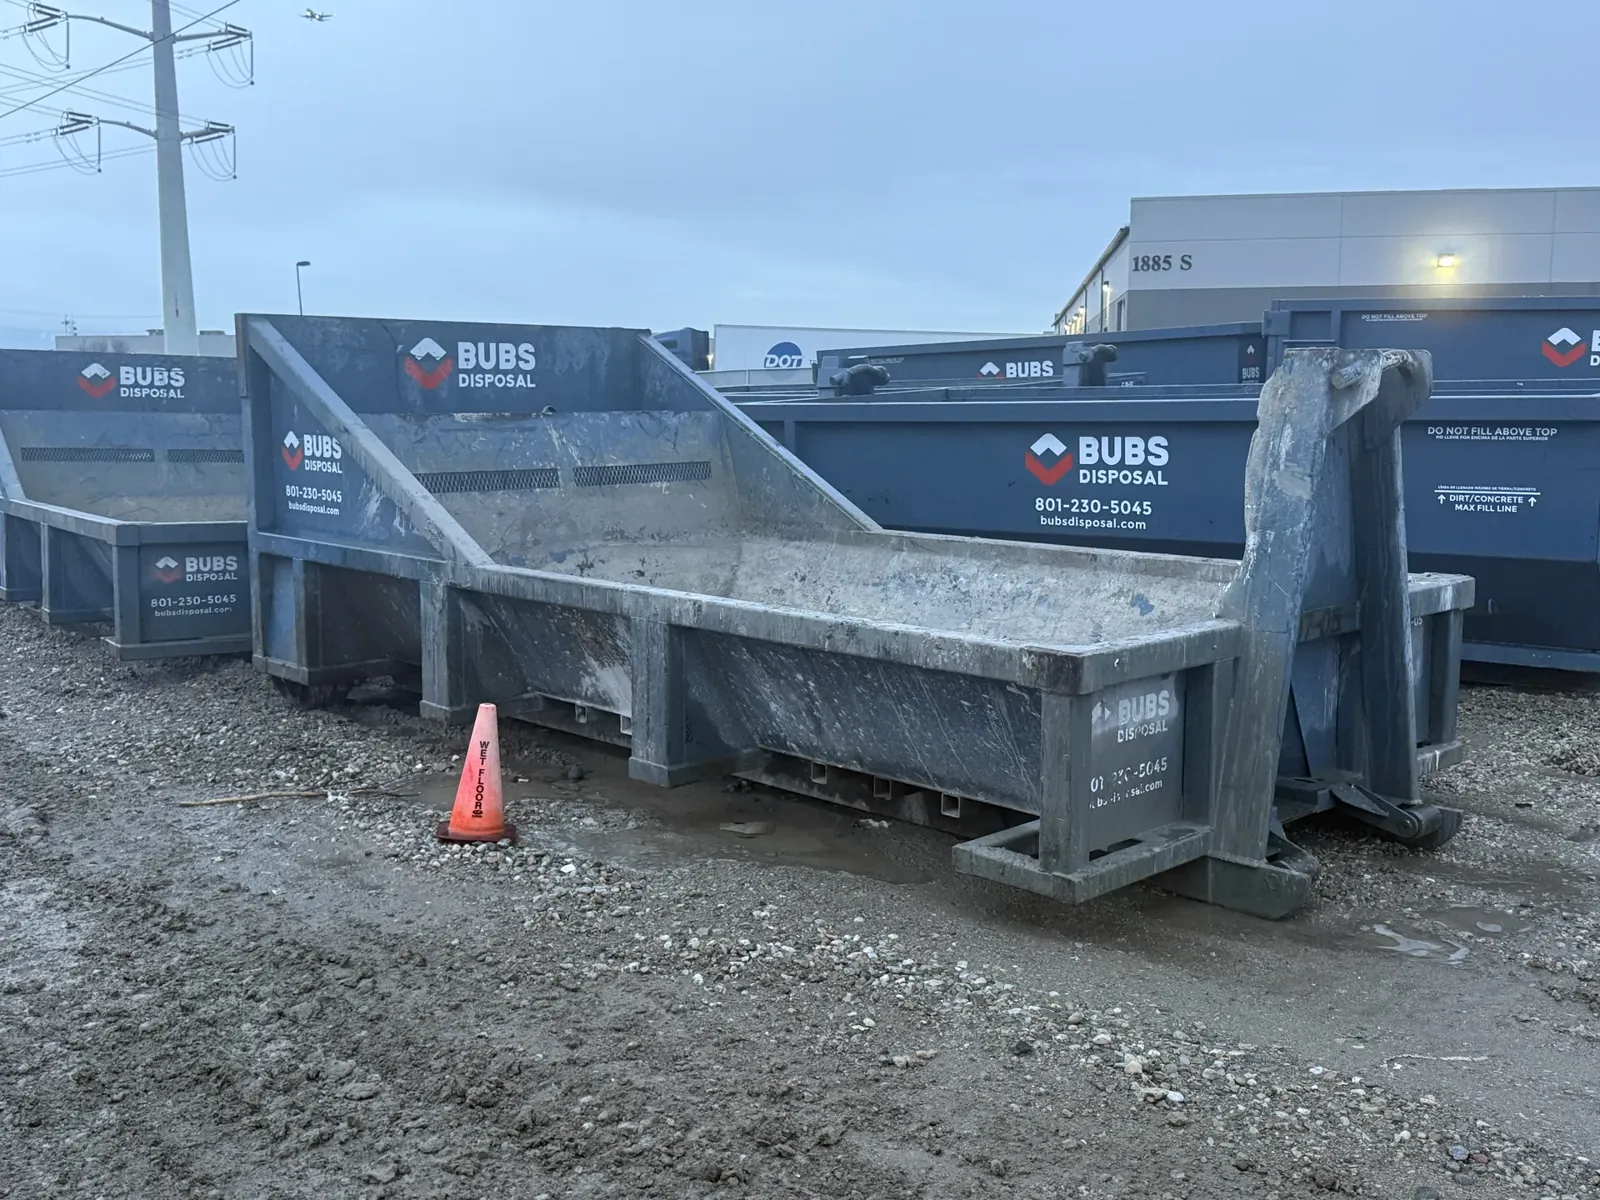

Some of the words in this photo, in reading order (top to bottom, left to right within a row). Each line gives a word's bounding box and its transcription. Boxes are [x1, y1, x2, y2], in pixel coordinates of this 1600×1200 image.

[1132, 255, 1172, 272] 1885
[1180, 254, 1192, 271] S
[457, 341, 536, 371] BUBS
[765, 354, 803, 368] DOT
[119, 366, 185, 387] BUBS
[1006, 360, 1054, 378] BUBS
[1242, 366, 1260, 379] BUBS
[458, 373, 536, 388] DISPOSAL
[120, 387, 185, 399] DISPOSAL
[1427, 426, 1444, 435] DO
[1446, 426, 1469, 435] NOT
[1471, 427, 1492, 436] FILL
[1494, 427, 1532, 436] ABOVE
[1535, 427, 1558, 436] TOP
[304, 434, 342, 460] BUBS
[1079, 435, 1169, 467] BUBS
[304, 459, 343, 474] DISPOSAL
[1079, 469, 1169, 486] DISPOSAL
[285, 484, 342, 503] 801-230-5045
[1449, 494, 1524, 504] DIRT/CONCRETE
[288, 500, 340, 516] bubsdisposal.com
[1035, 497, 1152, 515] 801-230-5045
[1454, 504, 1475, 512] MAX
[1477, 504, 1495, 512] FILL
[1496, 505, 1518, 513] LINE
[1040, 515, 1146, 530] bubsdisposal.com
[185, 556, 238, 572] BUBS
[186, 572, 238, 582] DISPOSAL
[150, 594, 236, 608] 801-230-5045
[154, 606, 232, 617] bubsdisposal.com
[1118, 689, 1170, 726] BUBS
[1117, 720, 1169, 743] DISPOSAL
[479, 741, 490, 766] WET
[474, 769, 485, 810] FLOOR
